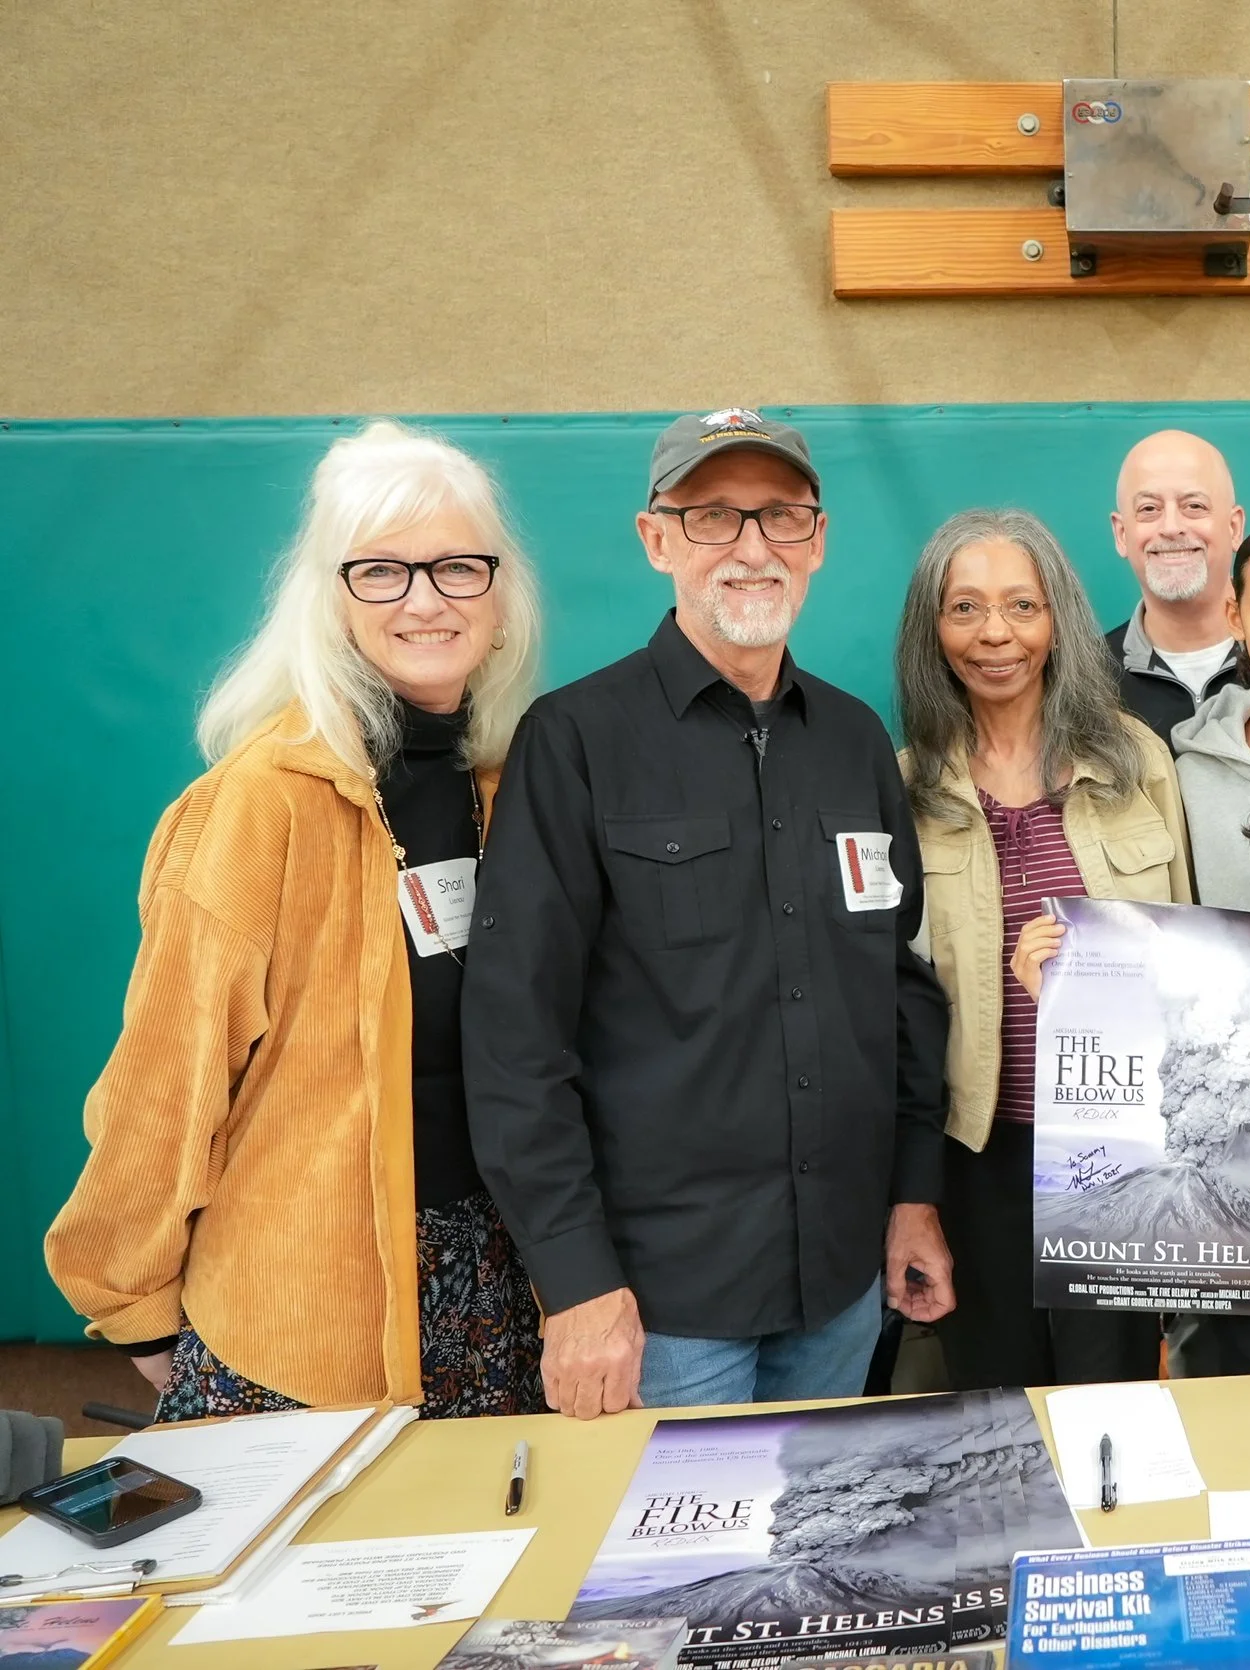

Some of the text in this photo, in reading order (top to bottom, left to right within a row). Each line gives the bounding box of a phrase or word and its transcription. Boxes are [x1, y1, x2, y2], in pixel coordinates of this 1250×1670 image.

[1055, 1035, 1100, 1053] THE
[1055, 1053, 1144, 1087] FIRE
[1055, 1086, 1144, 1102] BELOW US
[1073, 1107, 1120, 1120] REDUX
[1040, 1236, 1145, 1261] MOUNT
[1153, 1240, 1188, 1262] ST.
[1174, 1277, 1187, 1285] they
[1069, 1283, 1089, 1294] GLOBAL
[1088, 1284, 1099, 1294] NET
[1099, 1284, 1134, 1296] PRODUCTIONS
[1159, 1287, 1170, 1297] FIRE
[1171, 1288, 1190, 1298] BELOW
[1219, 1289, 1241, 1300] MICHAEL
[1113, 1296, 1131, 1306] GRANT
[1166, 1298, 1177, 1308] RON
[1177, 1299, 1192, 1309] ERAK
[1201, 1299, 1215, 1310] RICK
[646, 1494, 703, 1508] THE
[636, 1499, 754, 1527] FIRE
[631, 1519, 750, 1537] BELOW US
[1028, 1556, 1050, 1564] What
[1050, 1554, 1073, 1562] Every
[1073, 1551, 1109, 1560] Business
[1110, 1549, 1138, 1558] Should
[1138, 1547, 1161, 1555] Know
[1162, 1545, 1189, 1554] Before
[1189, 1543, 1222, 1552] Disaster
[1026, 1570, 1145, 1599] Business
[1024, 1593, 1152, 1622] Survival Kit
[577, 1620, 664, 1629] VOLCANOES
[732, 1605, 944, 1641] ST. HELENS
[1022, 1623, 1048, 1638] For
[1051, 1619, 1134, 1637] Earthquakes
[468, 1636, 511, 1646] Mount
[534, 1637, 581, 1646] Helens
[738, 1644, 762, 1652] earth
[1021, 1633, 1148, 1654] & Other Disasters
[692, 1651, 738, 1660] mountains
[759, 1648, 777, 1657] they
[812, 1642, 843, 1650] Psalms
[732, 1659, 750, 1670] FIRE
[750, 1655, 782, 1668] BELOW
[824, 1648, 857, 1659] MICHAEL
[859, 1645, 887, 1656] LIENAU
